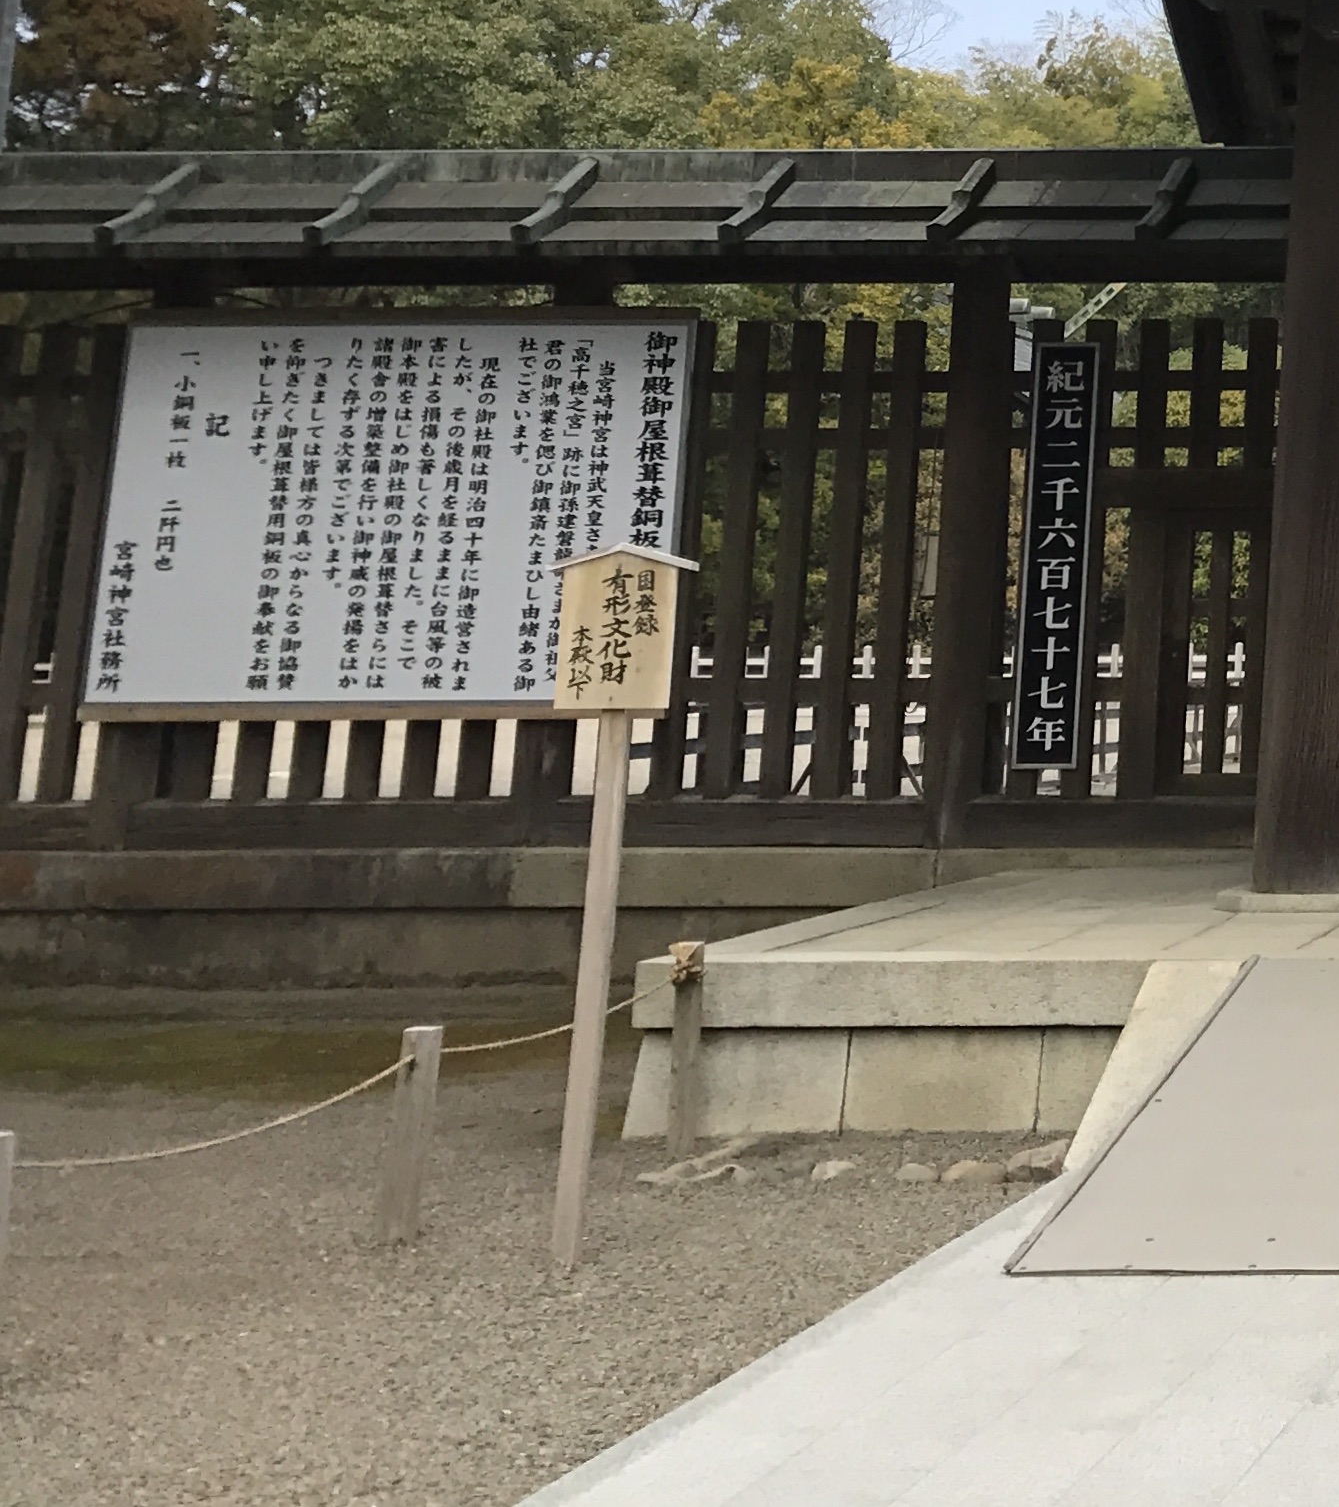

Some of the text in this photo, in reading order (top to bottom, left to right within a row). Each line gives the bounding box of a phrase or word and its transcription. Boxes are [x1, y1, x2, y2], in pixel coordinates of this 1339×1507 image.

[205, 411, 231, 437] 記
[247, 340, 279, 465] い申し上げます。
[321, 337, 363, 589] りたく存ずる次第でございます。
[509, 336, 538, 464] 社でございます。
[451, 356, 501, 691] 現在の御社殿は明治四十年に御造営されま
[1025, 360, 1085, 751] 紀元二千六百七十七年
[95, 540, 139, 694] 宮崎神宮社務所
[567, 625, 595, 700] 本殿以下
[596, 567, 635, 685] 有形文化財
[632, 570, 660, 636] 国登録
